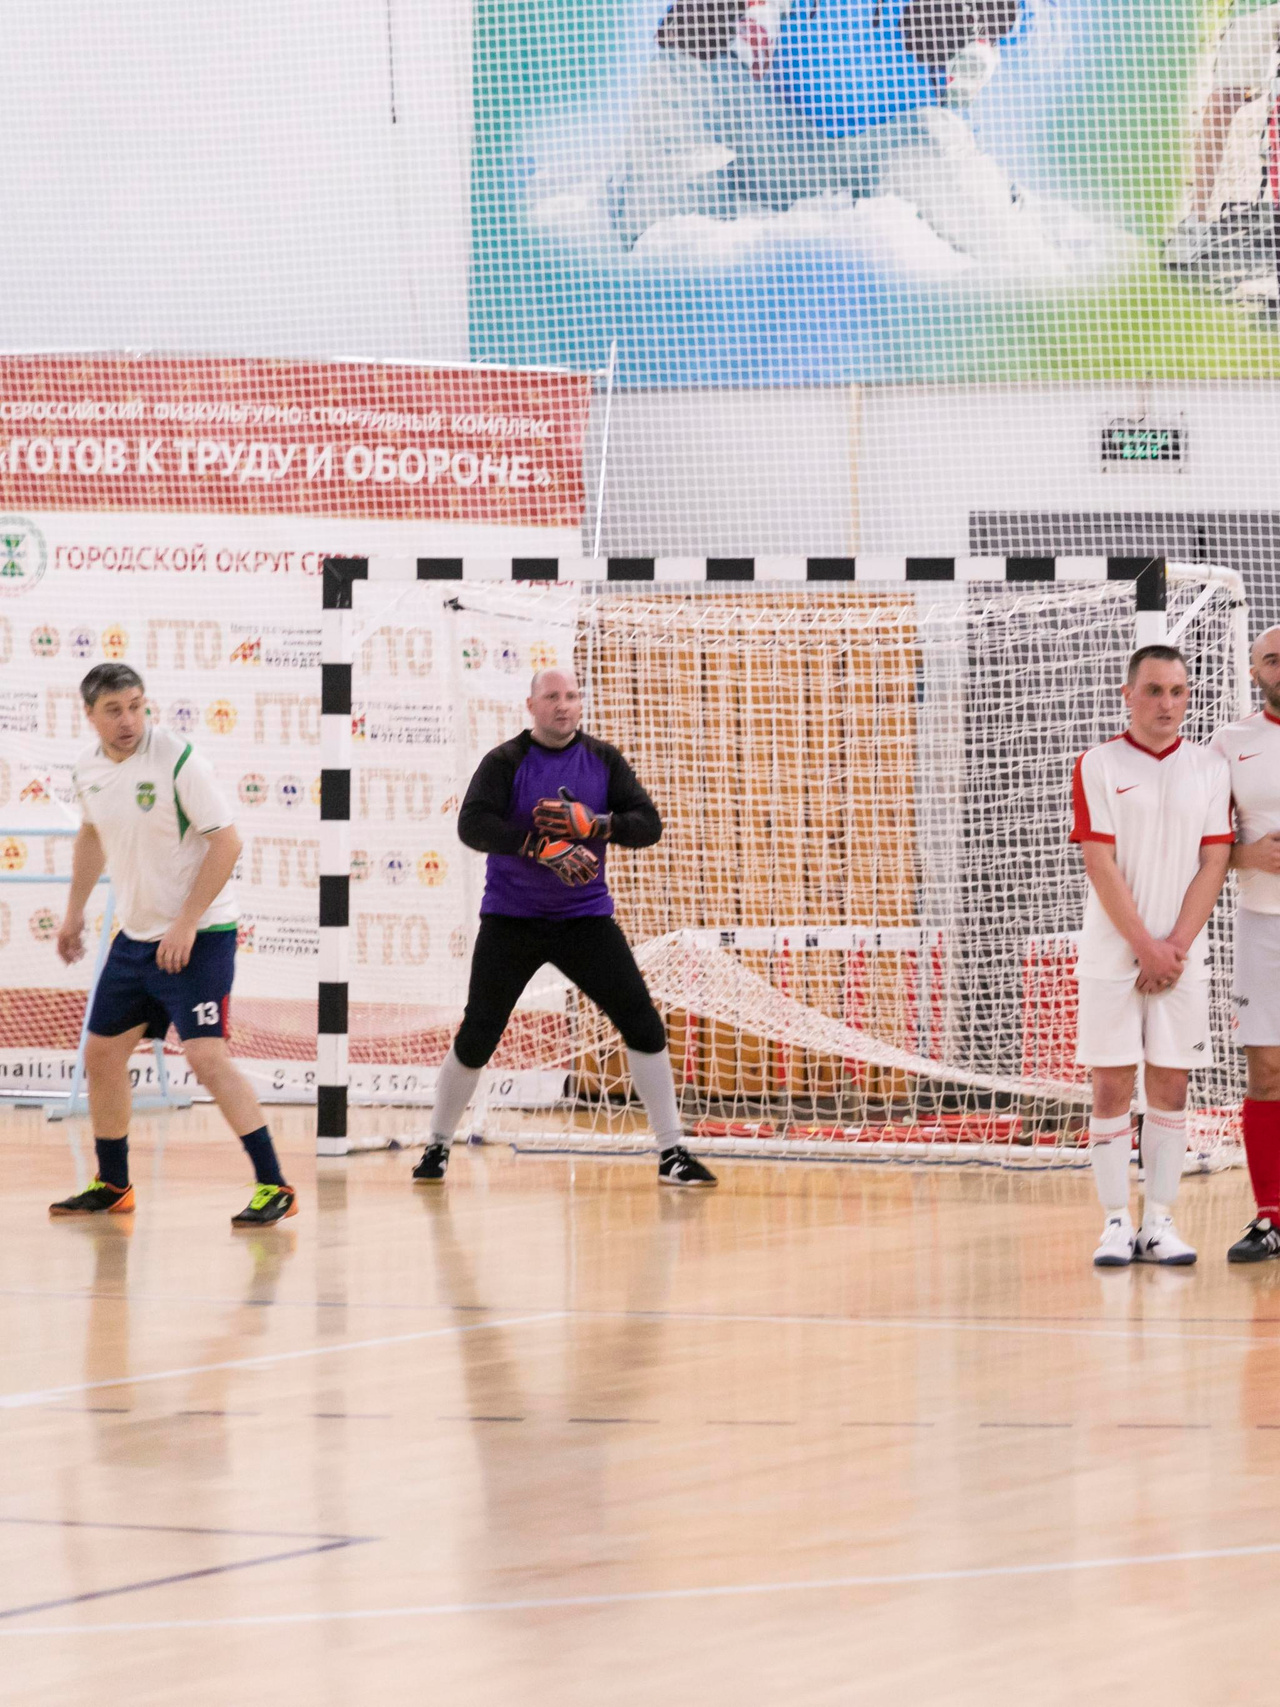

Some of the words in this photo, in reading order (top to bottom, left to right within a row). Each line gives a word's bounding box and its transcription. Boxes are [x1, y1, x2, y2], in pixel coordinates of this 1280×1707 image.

[0, 399, 145, 420] СЕРОССИЙСКИЙ
[450, 413, 556, 438] КОМПЛЕКС
[138, 438, 164, 475] К
[172, 440, 296, 483] ТРУДУ
[305, 445, 333, 481] И
[343, 444, 551, 488] ОБОРОНЕ»
[54, 544, 206, 573] ГОРОДСКОЙ
[216, 547, 296, 574] ОКРУГ
[192, 1001, 220, 1026] 13
